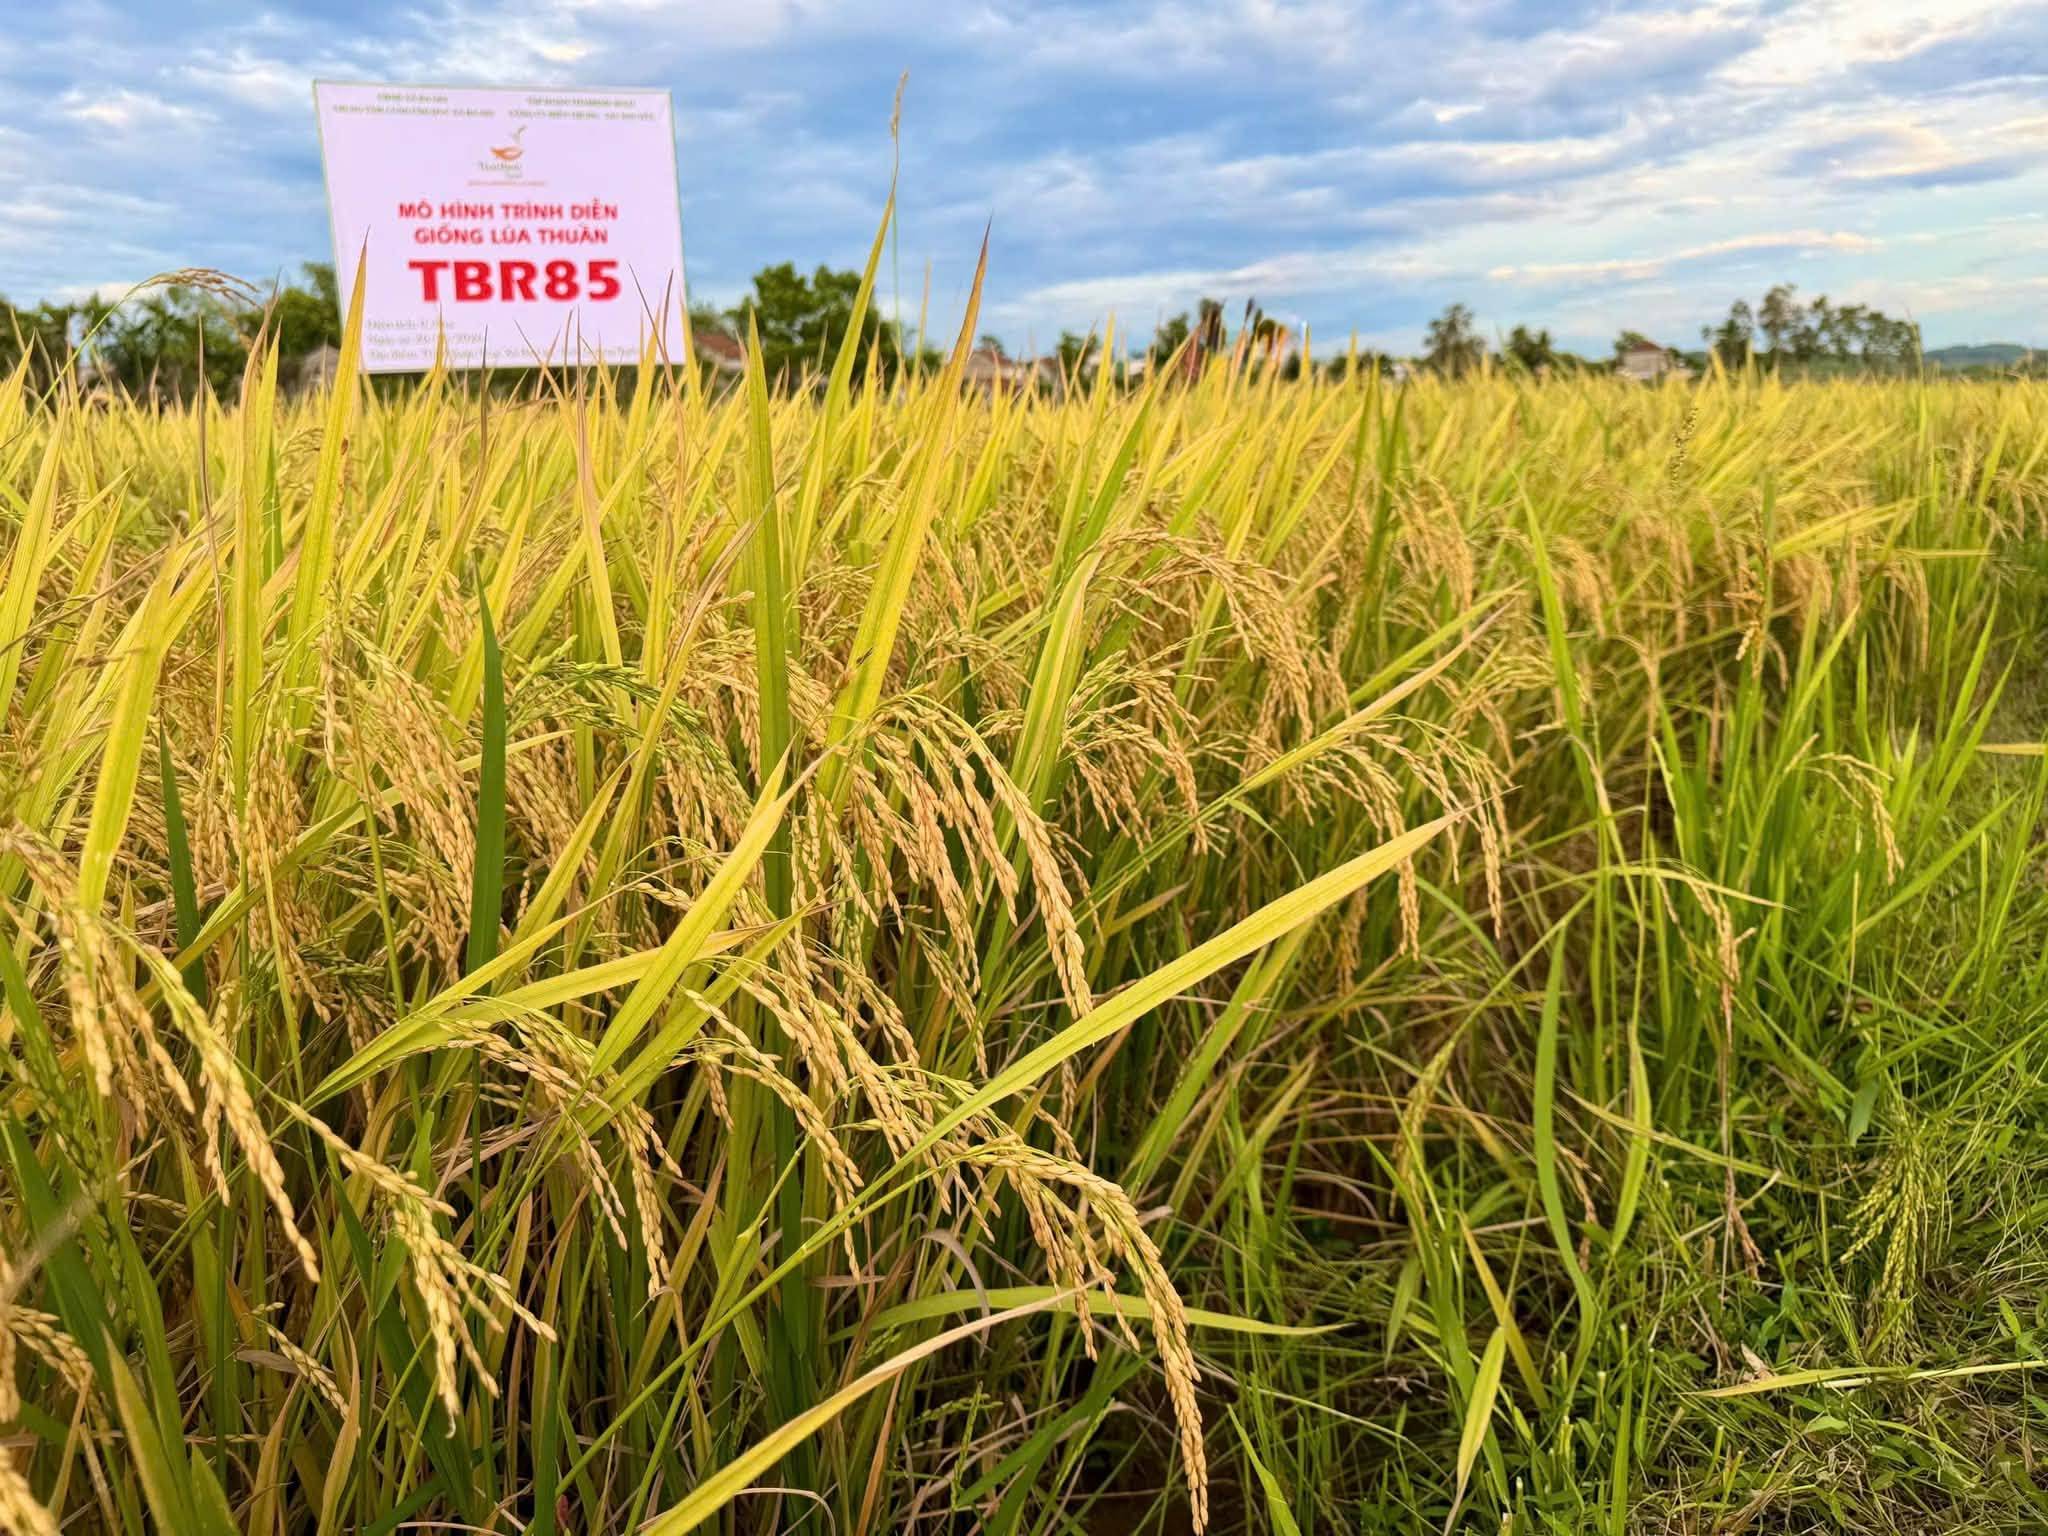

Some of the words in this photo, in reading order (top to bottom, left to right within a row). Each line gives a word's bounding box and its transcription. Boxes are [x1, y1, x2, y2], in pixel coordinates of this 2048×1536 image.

[398, 200, 433, 219] MÔ
[440, 202, 494, 219] HÌNH
[501, 202, 563, 220] TRÌNH
[414, 223, 484, 244] GIỐNG
[491, 224, 531, 244] LÚA
[408, 259, 621, 302] TBR85
